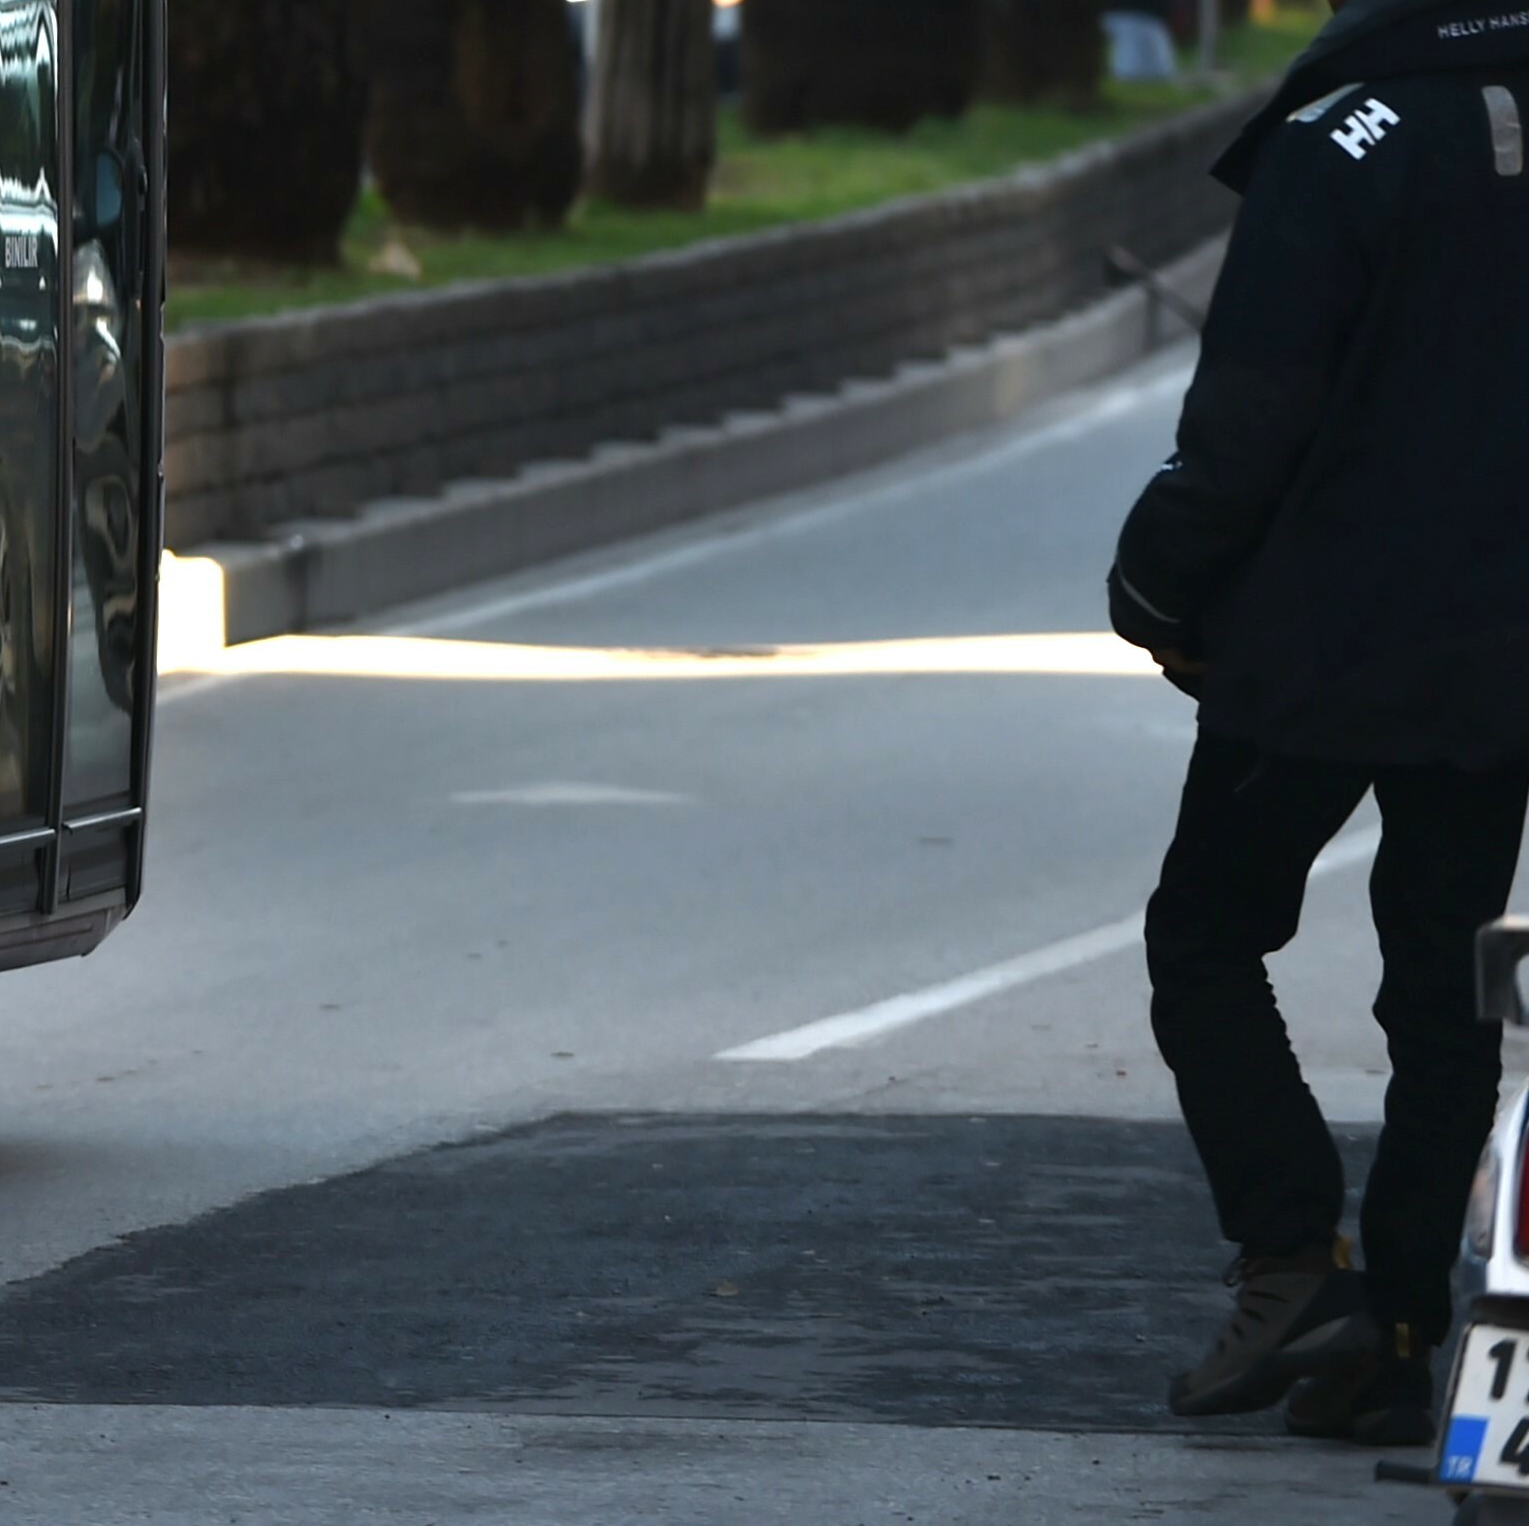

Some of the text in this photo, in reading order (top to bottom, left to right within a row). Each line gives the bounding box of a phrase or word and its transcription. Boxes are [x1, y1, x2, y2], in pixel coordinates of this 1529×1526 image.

[1438, 9, 1529, 39] HELLY HANS
[1488, 1338, 1529, 1403] 1
[1446, 1456, 1474, 1477] TR
